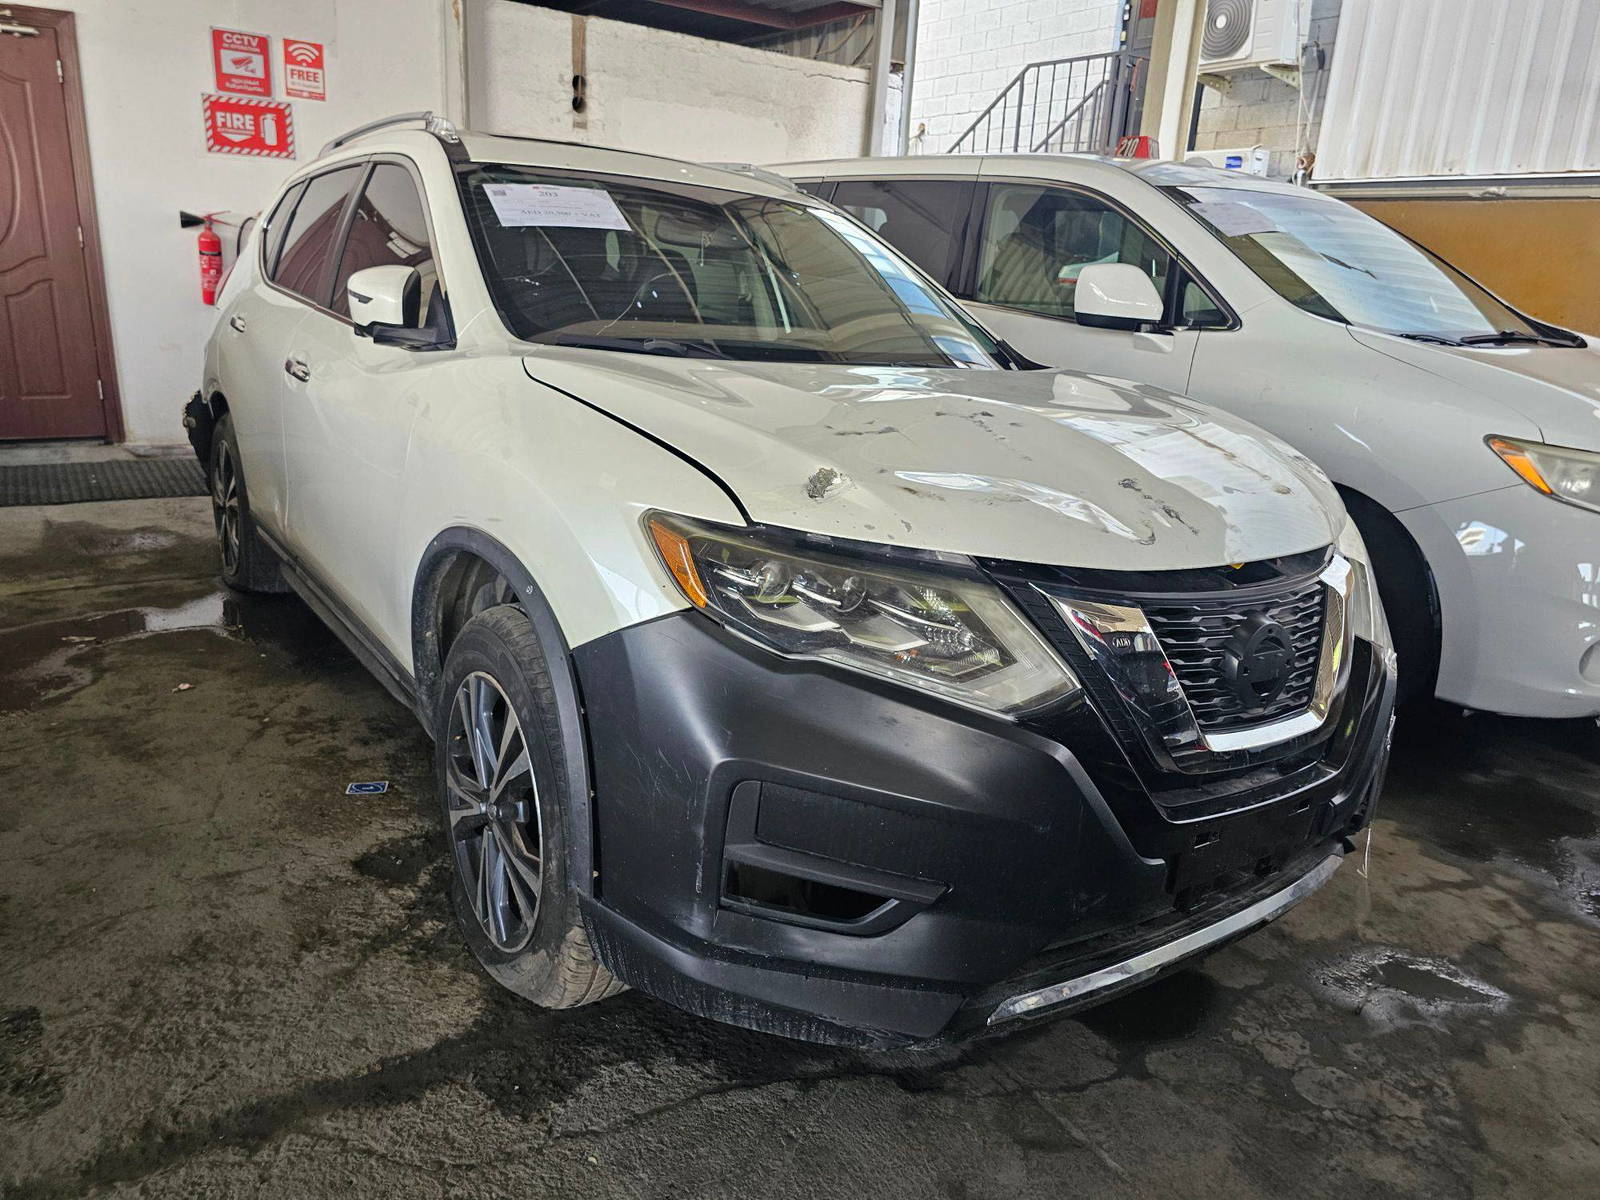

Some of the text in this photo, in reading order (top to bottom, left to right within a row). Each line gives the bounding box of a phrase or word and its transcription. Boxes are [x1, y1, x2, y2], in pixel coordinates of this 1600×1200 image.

[223, 33, 258, 47] CCTV
[290, 68, 320, 83] FREE
[215, 111, 255, 129] FIRE
[1117, 138, 1140, 158] 210
